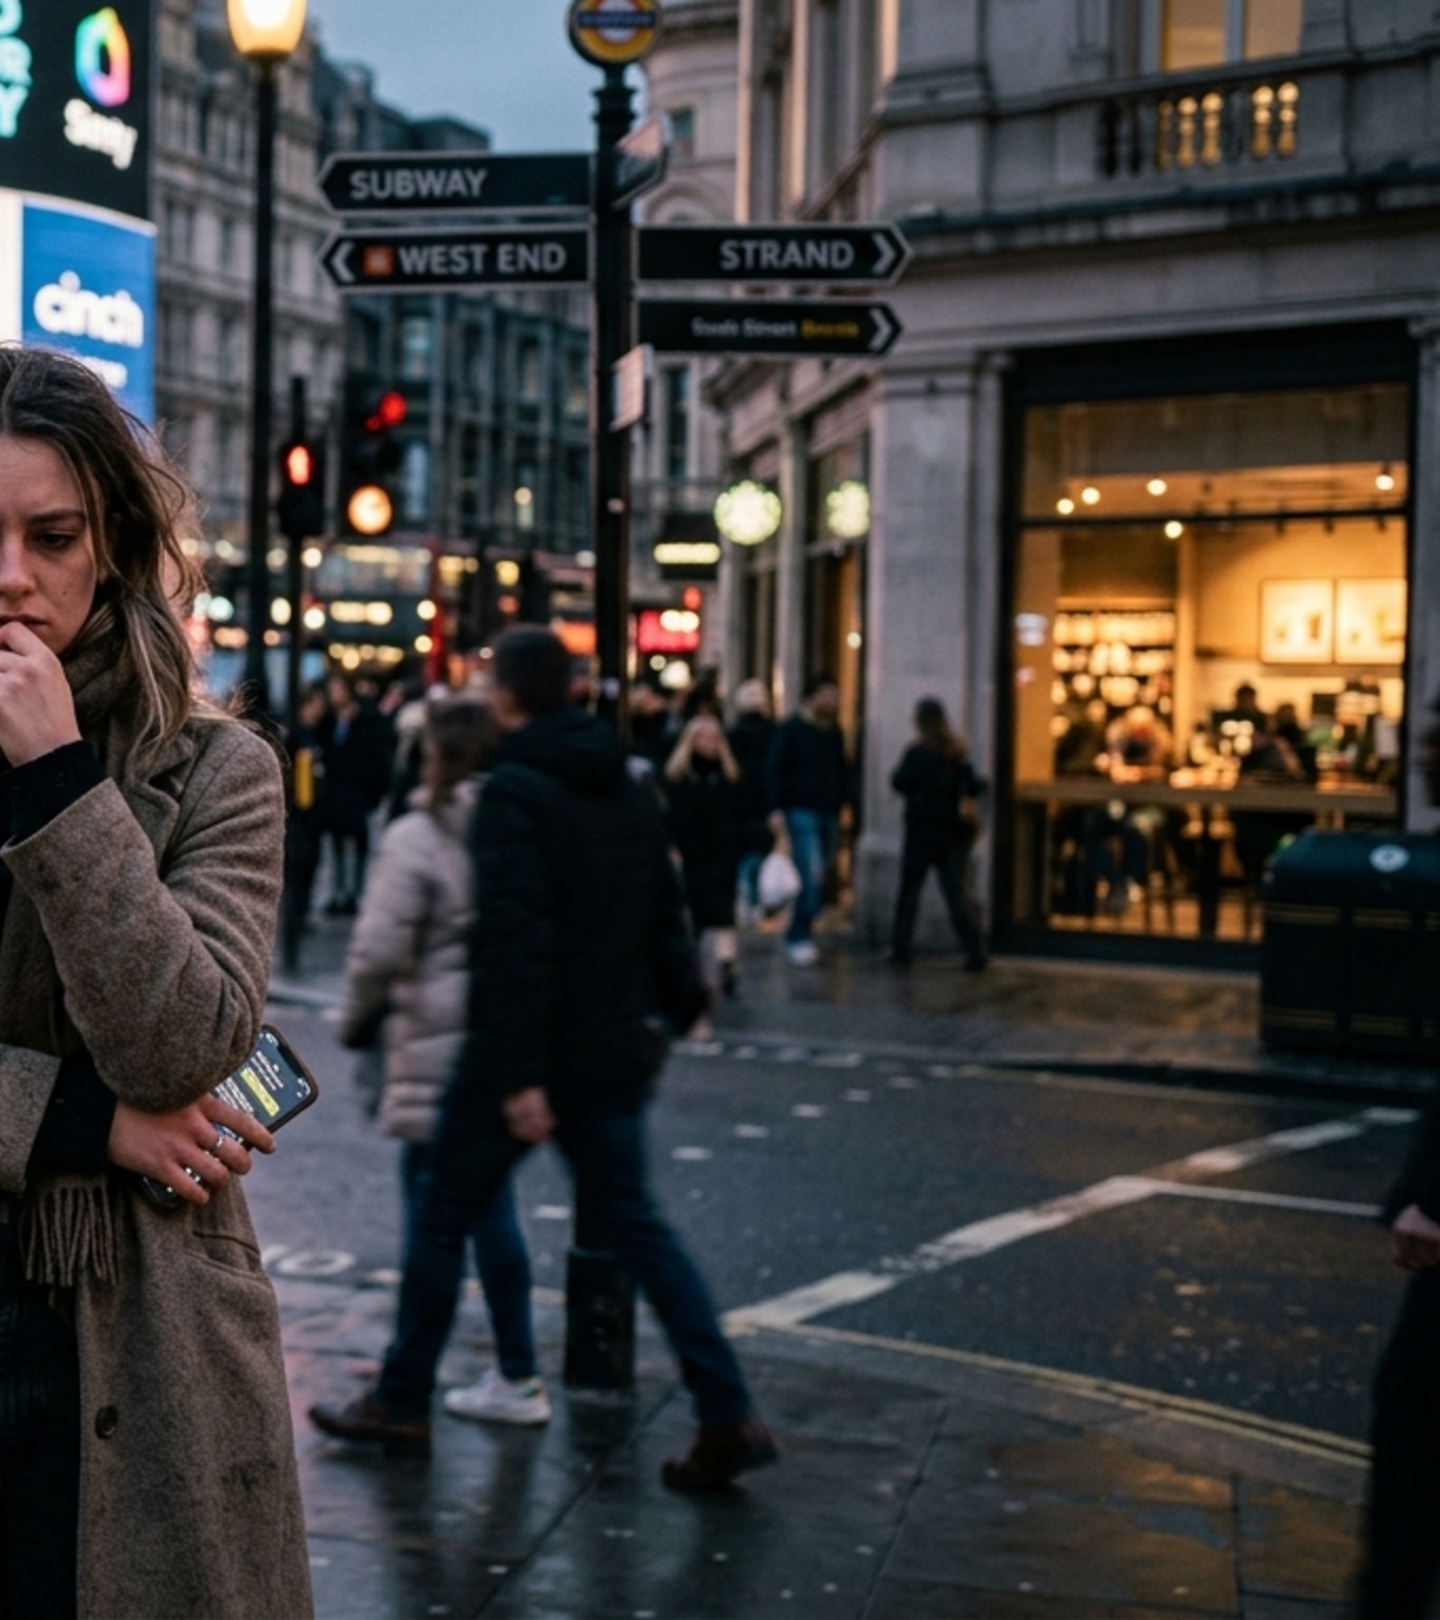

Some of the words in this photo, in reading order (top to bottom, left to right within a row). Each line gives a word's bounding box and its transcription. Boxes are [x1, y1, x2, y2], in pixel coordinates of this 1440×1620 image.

[349, 169, 487, 199] SUBWAY
[398, 243, 488, 275] WEST
[496, 242, 567, 273] END
[719, 239, 855, 270] STRAND
